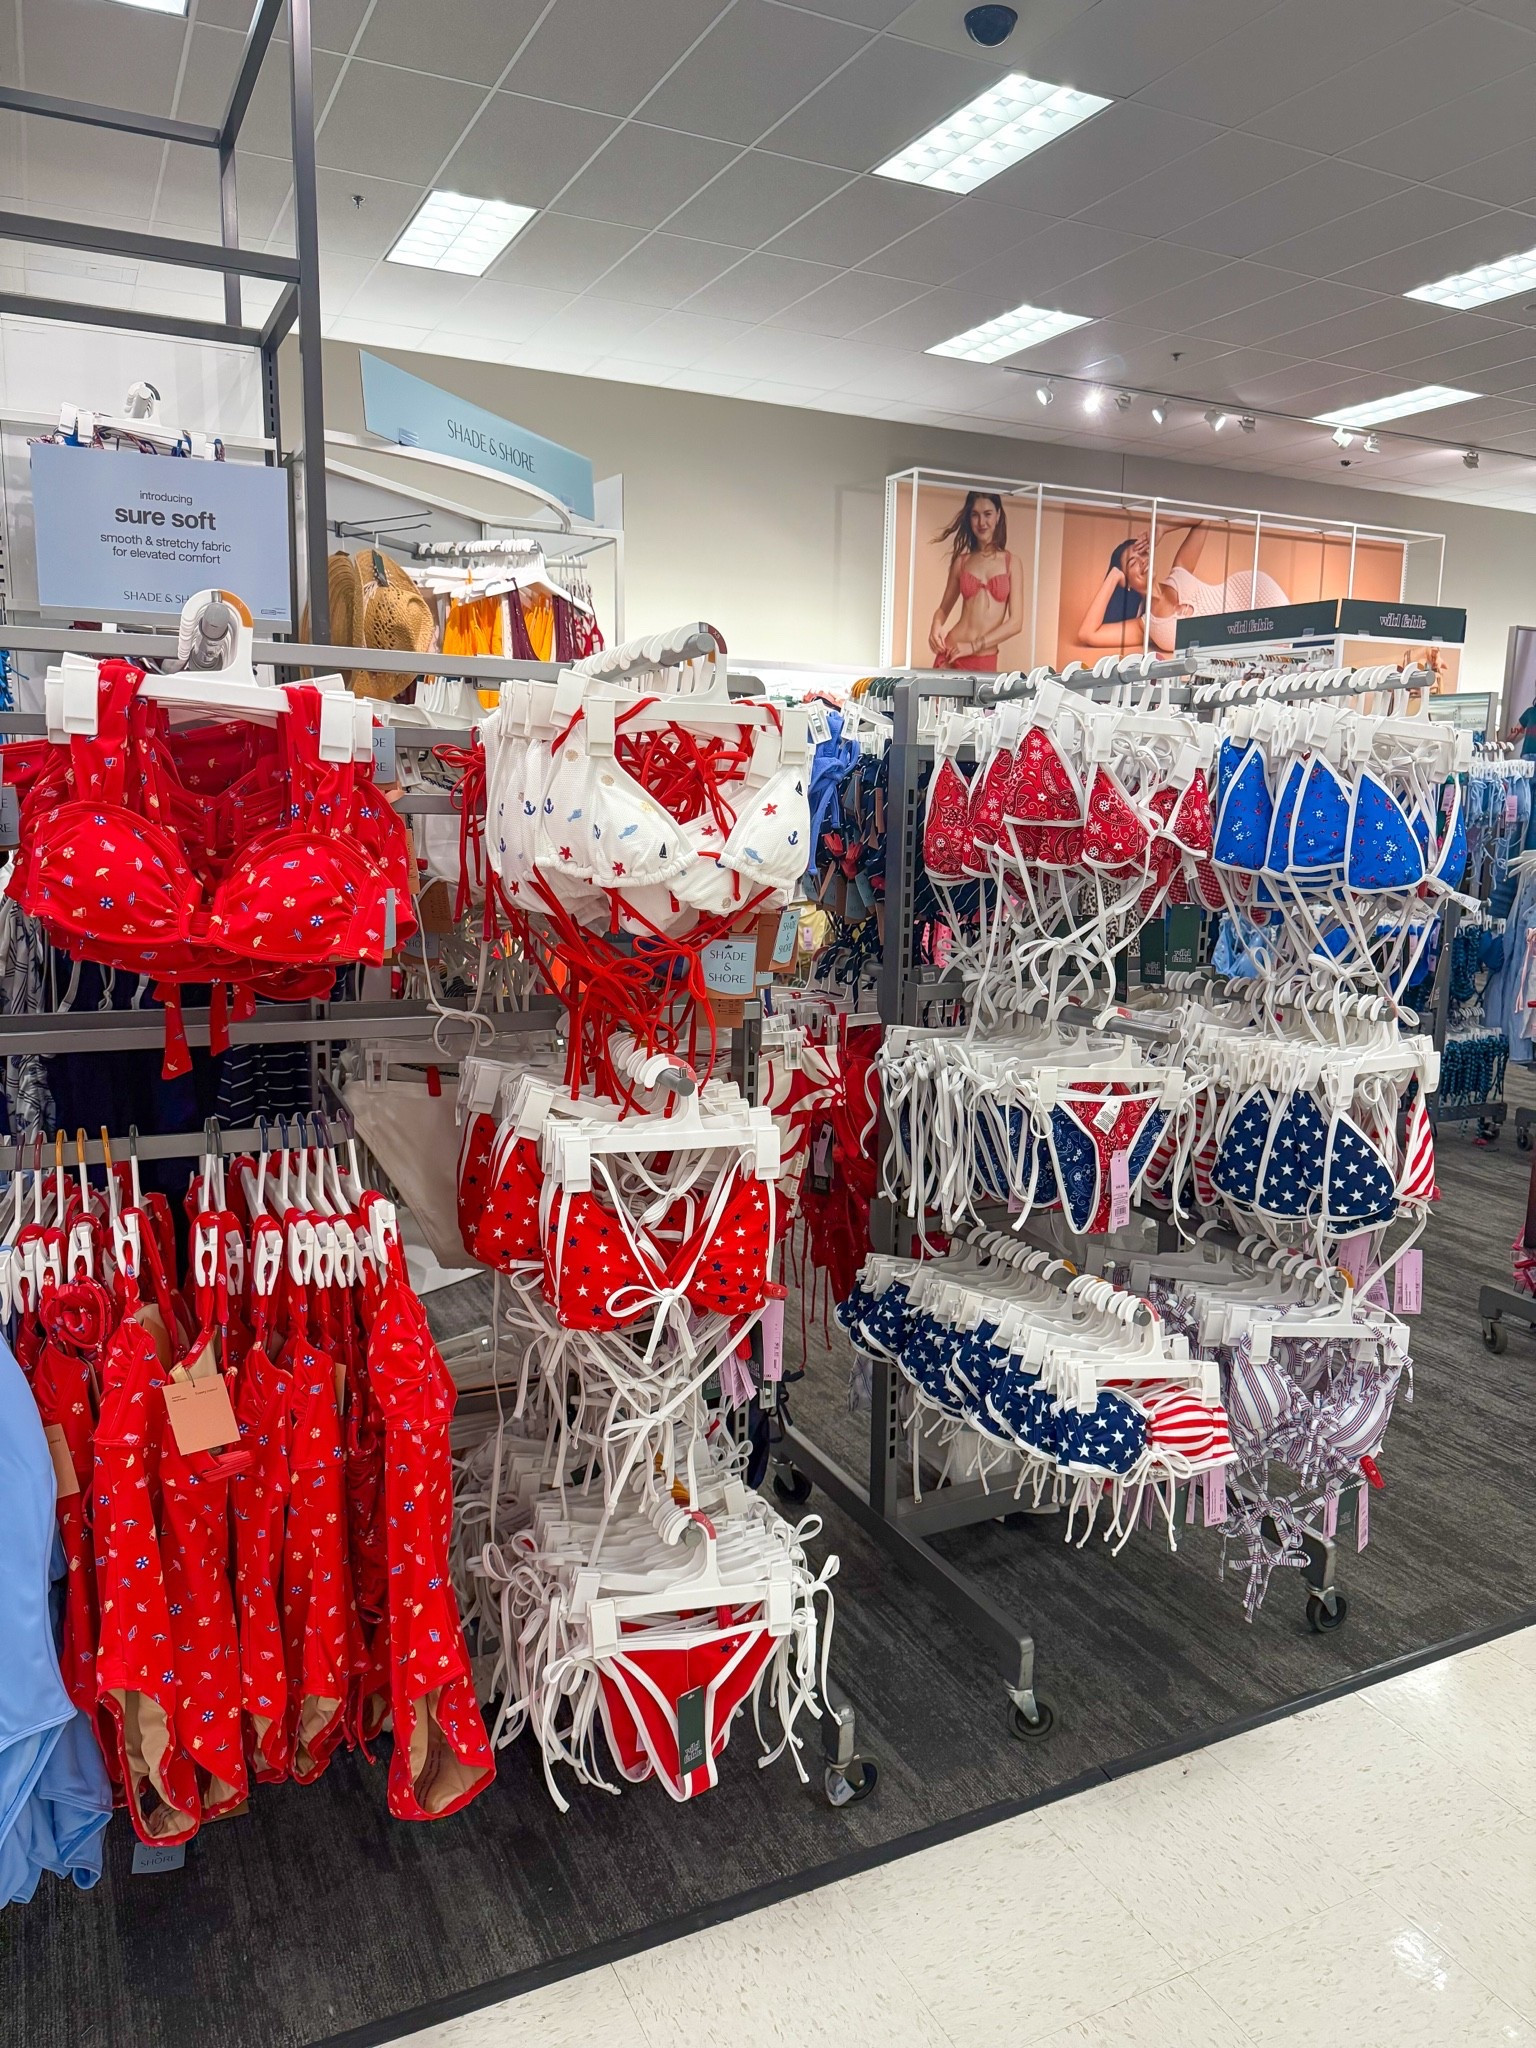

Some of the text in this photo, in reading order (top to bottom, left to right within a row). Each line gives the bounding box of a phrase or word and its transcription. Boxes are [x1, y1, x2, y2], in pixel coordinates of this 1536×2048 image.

[447, 419, 536, 474] SHADE & SHORE
[139, 490, 193, 506] introducing
[115, 507, 217, 531] sure soft
[100, 533, 232, 553] smooth & stretchy fabric
[112, 546, 221, 564] for elevated comfort
[123, 590, 162, 603] SHADE
[164, 593, 173, 603] &
[1227, 617, 1274, 635] wild fable
[1379, 612, 1427, 629] wild fable
[709, 949, 748, 962] SHADE
[723, 962, 732, 971] &
[708, 972, 747, 984] SHORE
